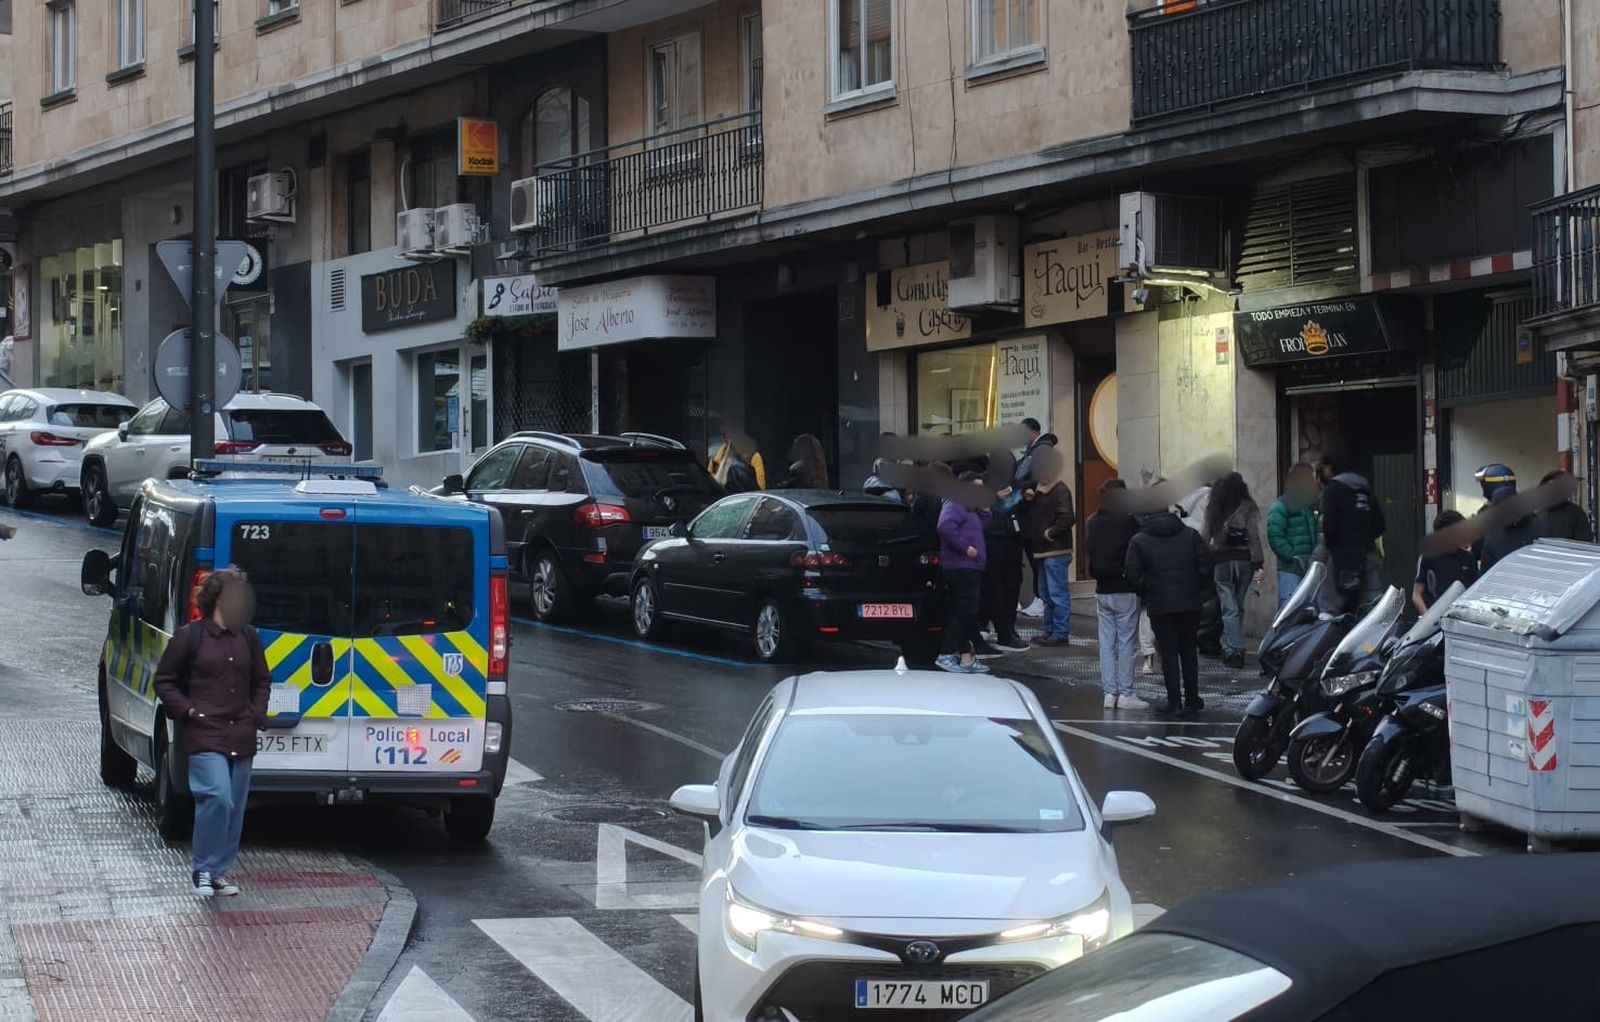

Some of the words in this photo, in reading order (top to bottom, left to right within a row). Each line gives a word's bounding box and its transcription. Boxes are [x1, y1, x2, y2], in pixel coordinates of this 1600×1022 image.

[468, 156, 495, 165] Kodak
[1034, 248, 1105, 309] Taqui
[376, 267, 438, 311] BUDA
[1250, 310, 1274, 322] TODO
[1274, 307, 1306, 319] EMPIEZA
[1306, 307, 1312, 315] Y
[1312, 303, 1345, 315] TERMINA
[1345, 302, 1357, 311] EN
[564, 311, 590, 342] José
[595, 307, 634, 334] Alberto
[999, 346, 1042, 386] Taqui
[240, 524, 270, 539] 723
[649, 528, 672, 538] 954
[864, 605, 890, 616] 7212
[256, 736, 285, 751] 875
[292, 736, 323, 752] FTX
[430, 727, 470, 743] Local
[873, 983, 927, 1005] 1774
[940, 983, 983, 1005] MCD
